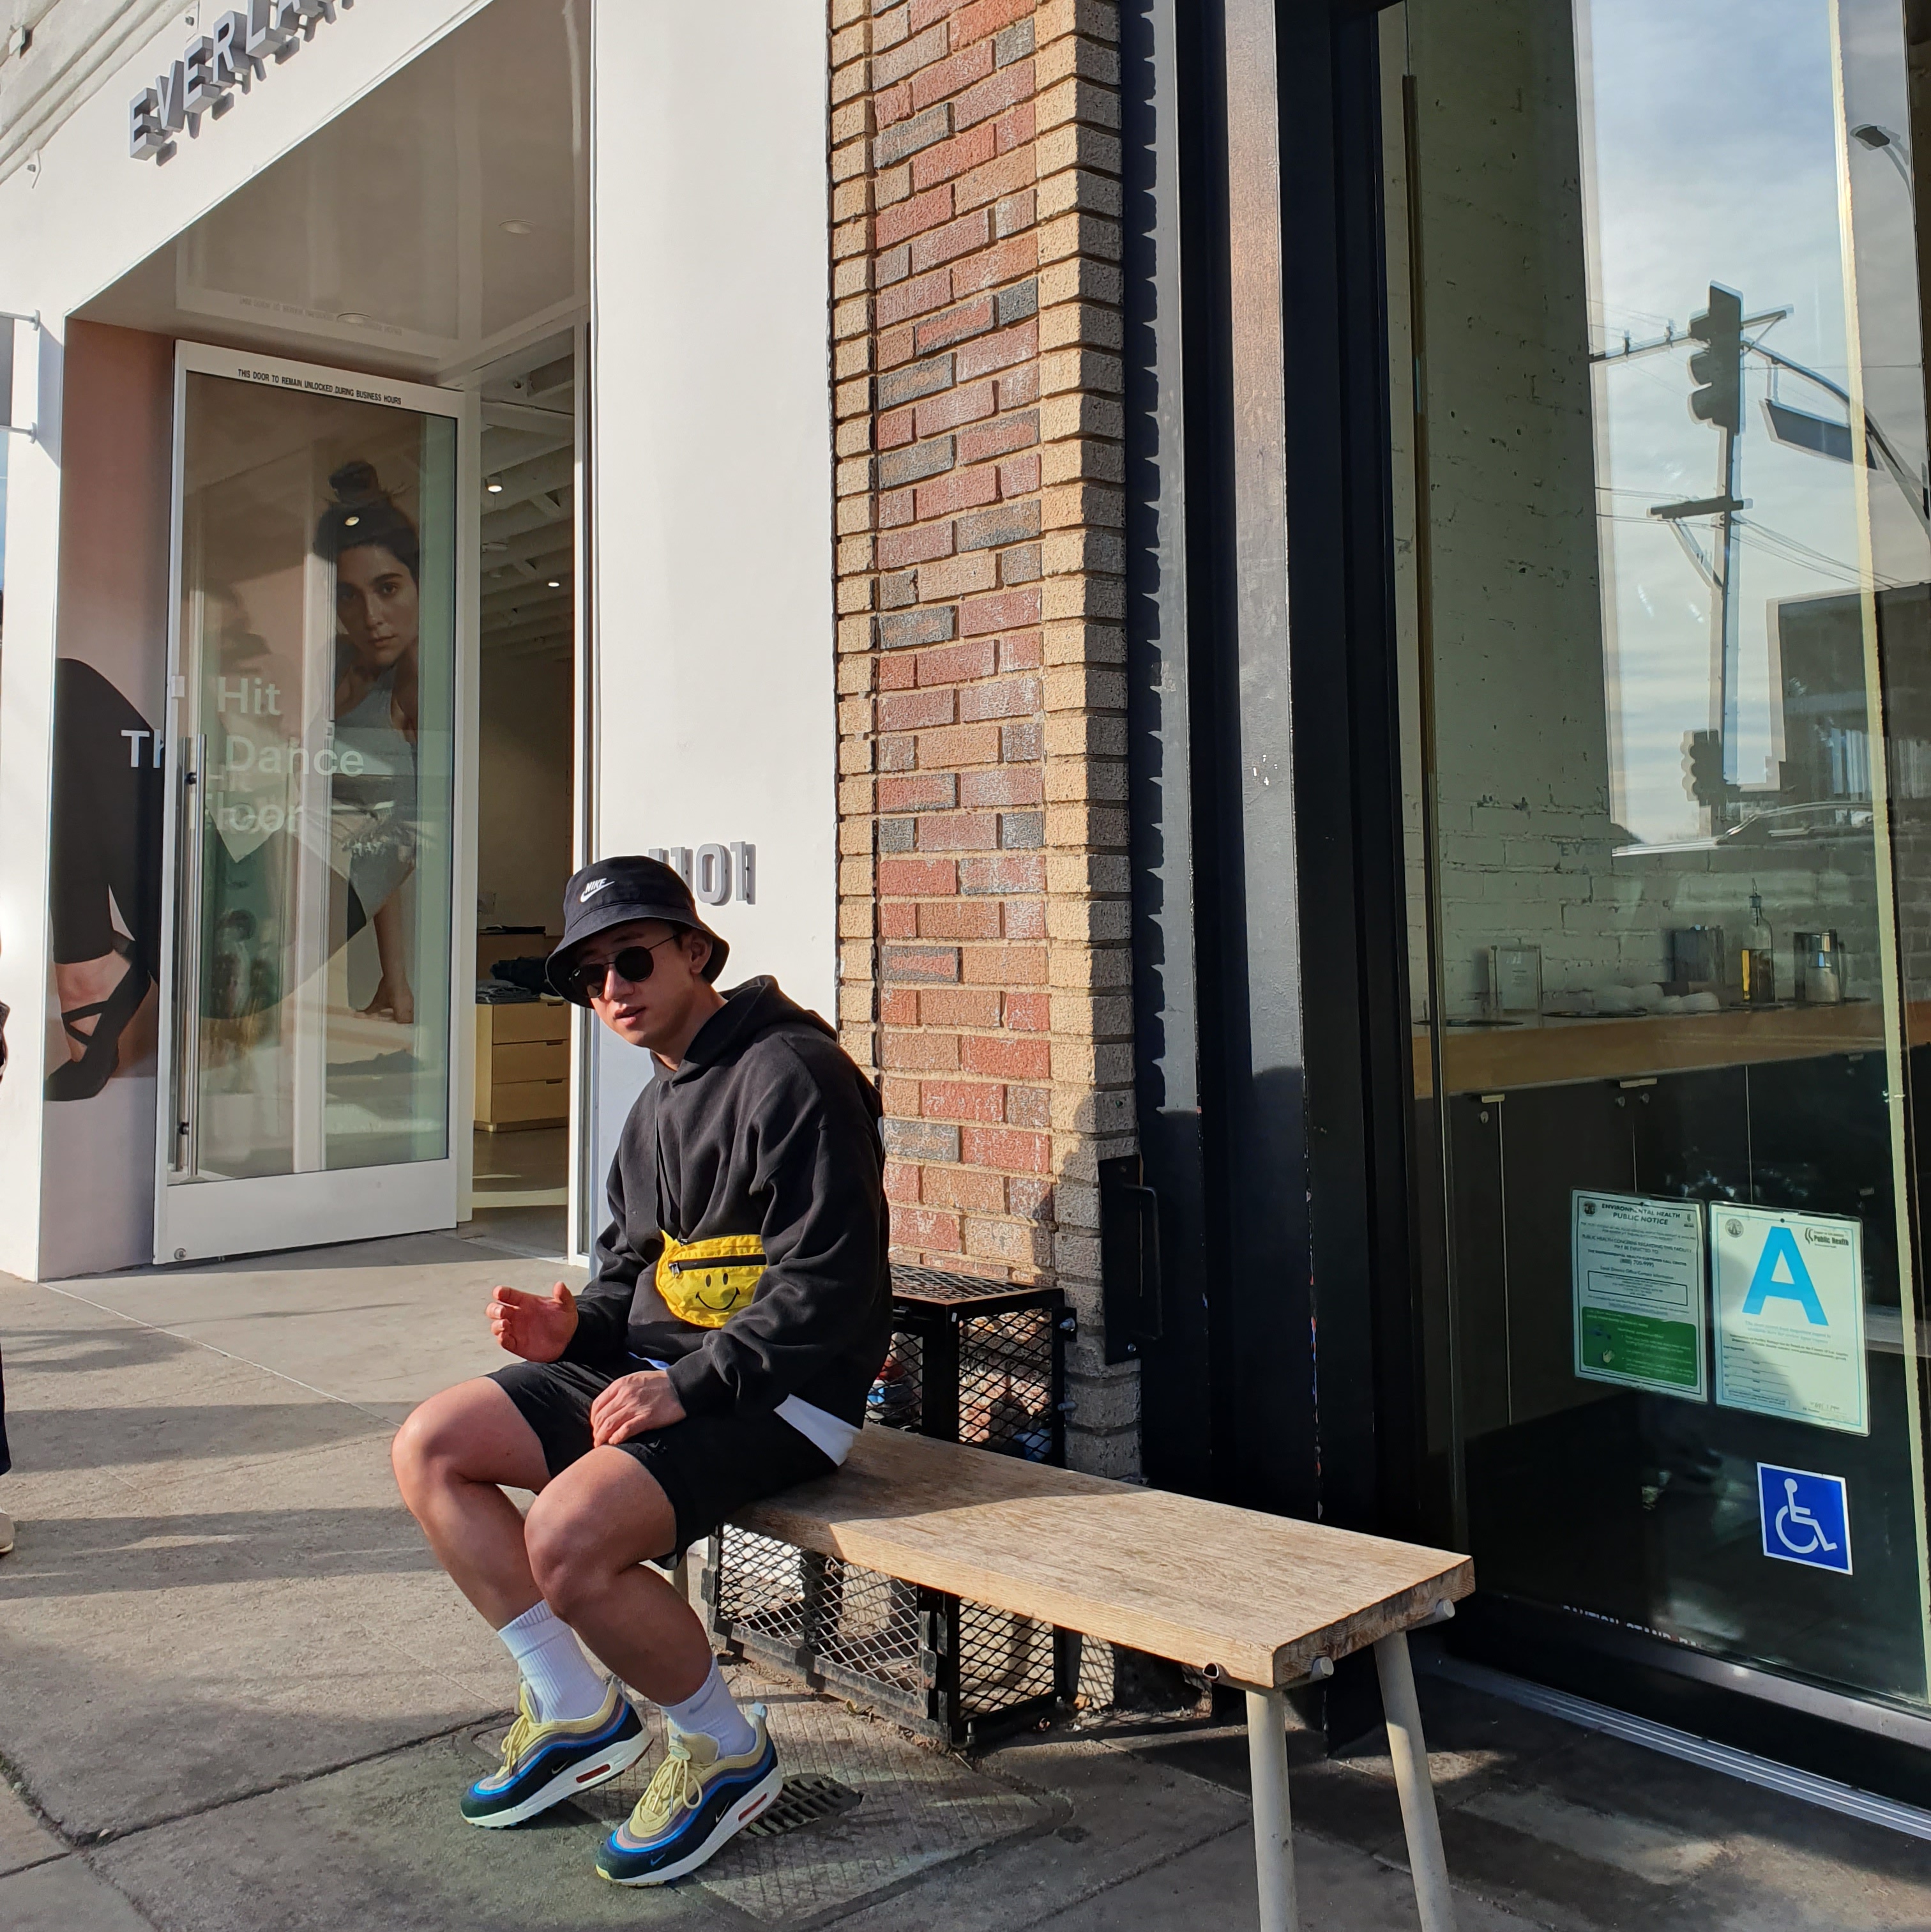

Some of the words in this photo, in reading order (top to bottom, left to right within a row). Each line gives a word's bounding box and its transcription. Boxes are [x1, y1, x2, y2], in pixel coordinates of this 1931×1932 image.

[238, 369, 250, 378] THIS
[253, 371, 269, 382] DOOR
[271, 374, 279, 383] TO
[282, 376, 302, 387] REMAIN
[305, 380, 333, 392] UNLOCKED
[335, 386, 354, 397] DURING
[356, 390, 381, 401] BUSINESS
[384, 394, 401, 405] HOURS
[217, 676, 282, 716] Hit
[226, 735, 365, 777] Dance
[585, 878, 607, 894] NIKE
[1613, 1212, 1639, 1221] PUBLIC
[1640, 1216, 1669, 1225] NOTICE
[1656, 1210, 1681, 1219] HEALTH
[1814, 1235, 1830, 1244] Public
[1741, 1226, 1829, 1327] A
